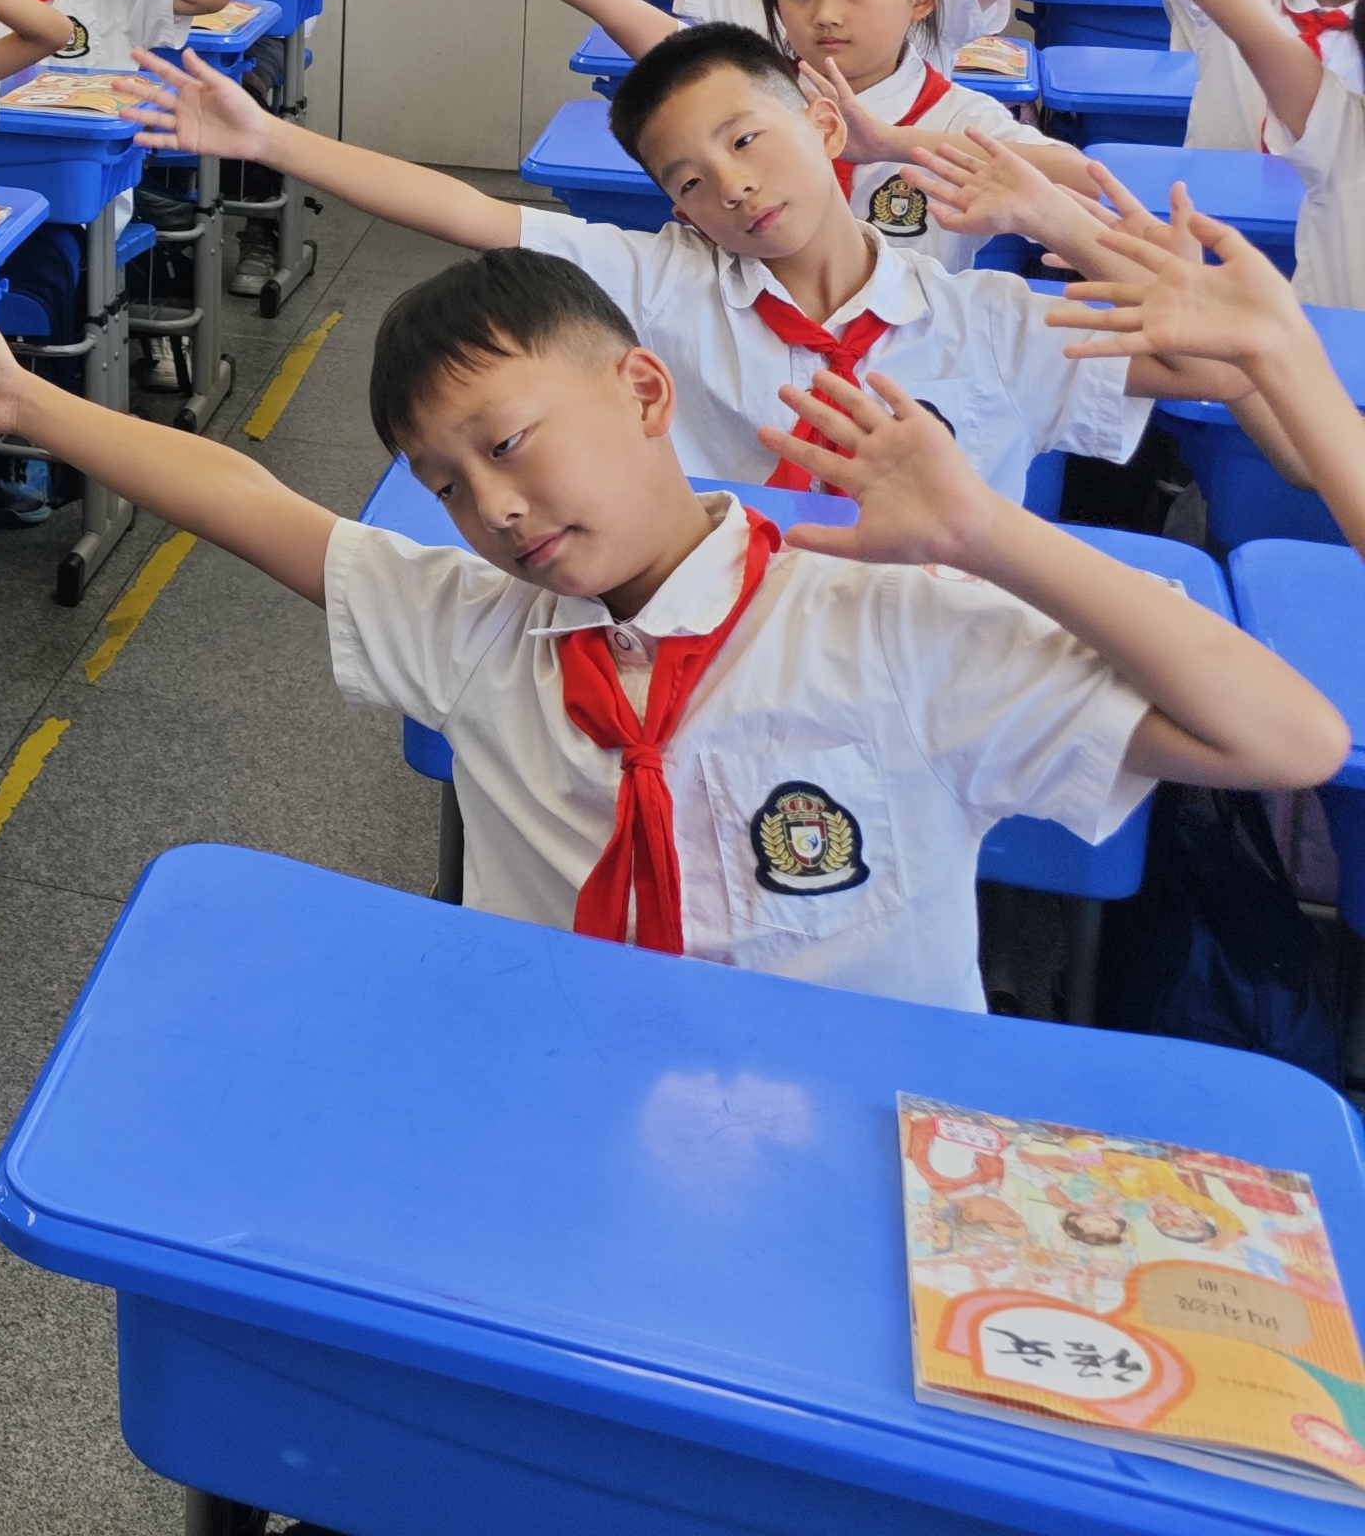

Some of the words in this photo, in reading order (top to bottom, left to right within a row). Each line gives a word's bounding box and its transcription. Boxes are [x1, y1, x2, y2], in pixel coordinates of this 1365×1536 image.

[1172, 1293, 1281, 1333] 四年级
[985, 1326, 1144, 1383] 语文
